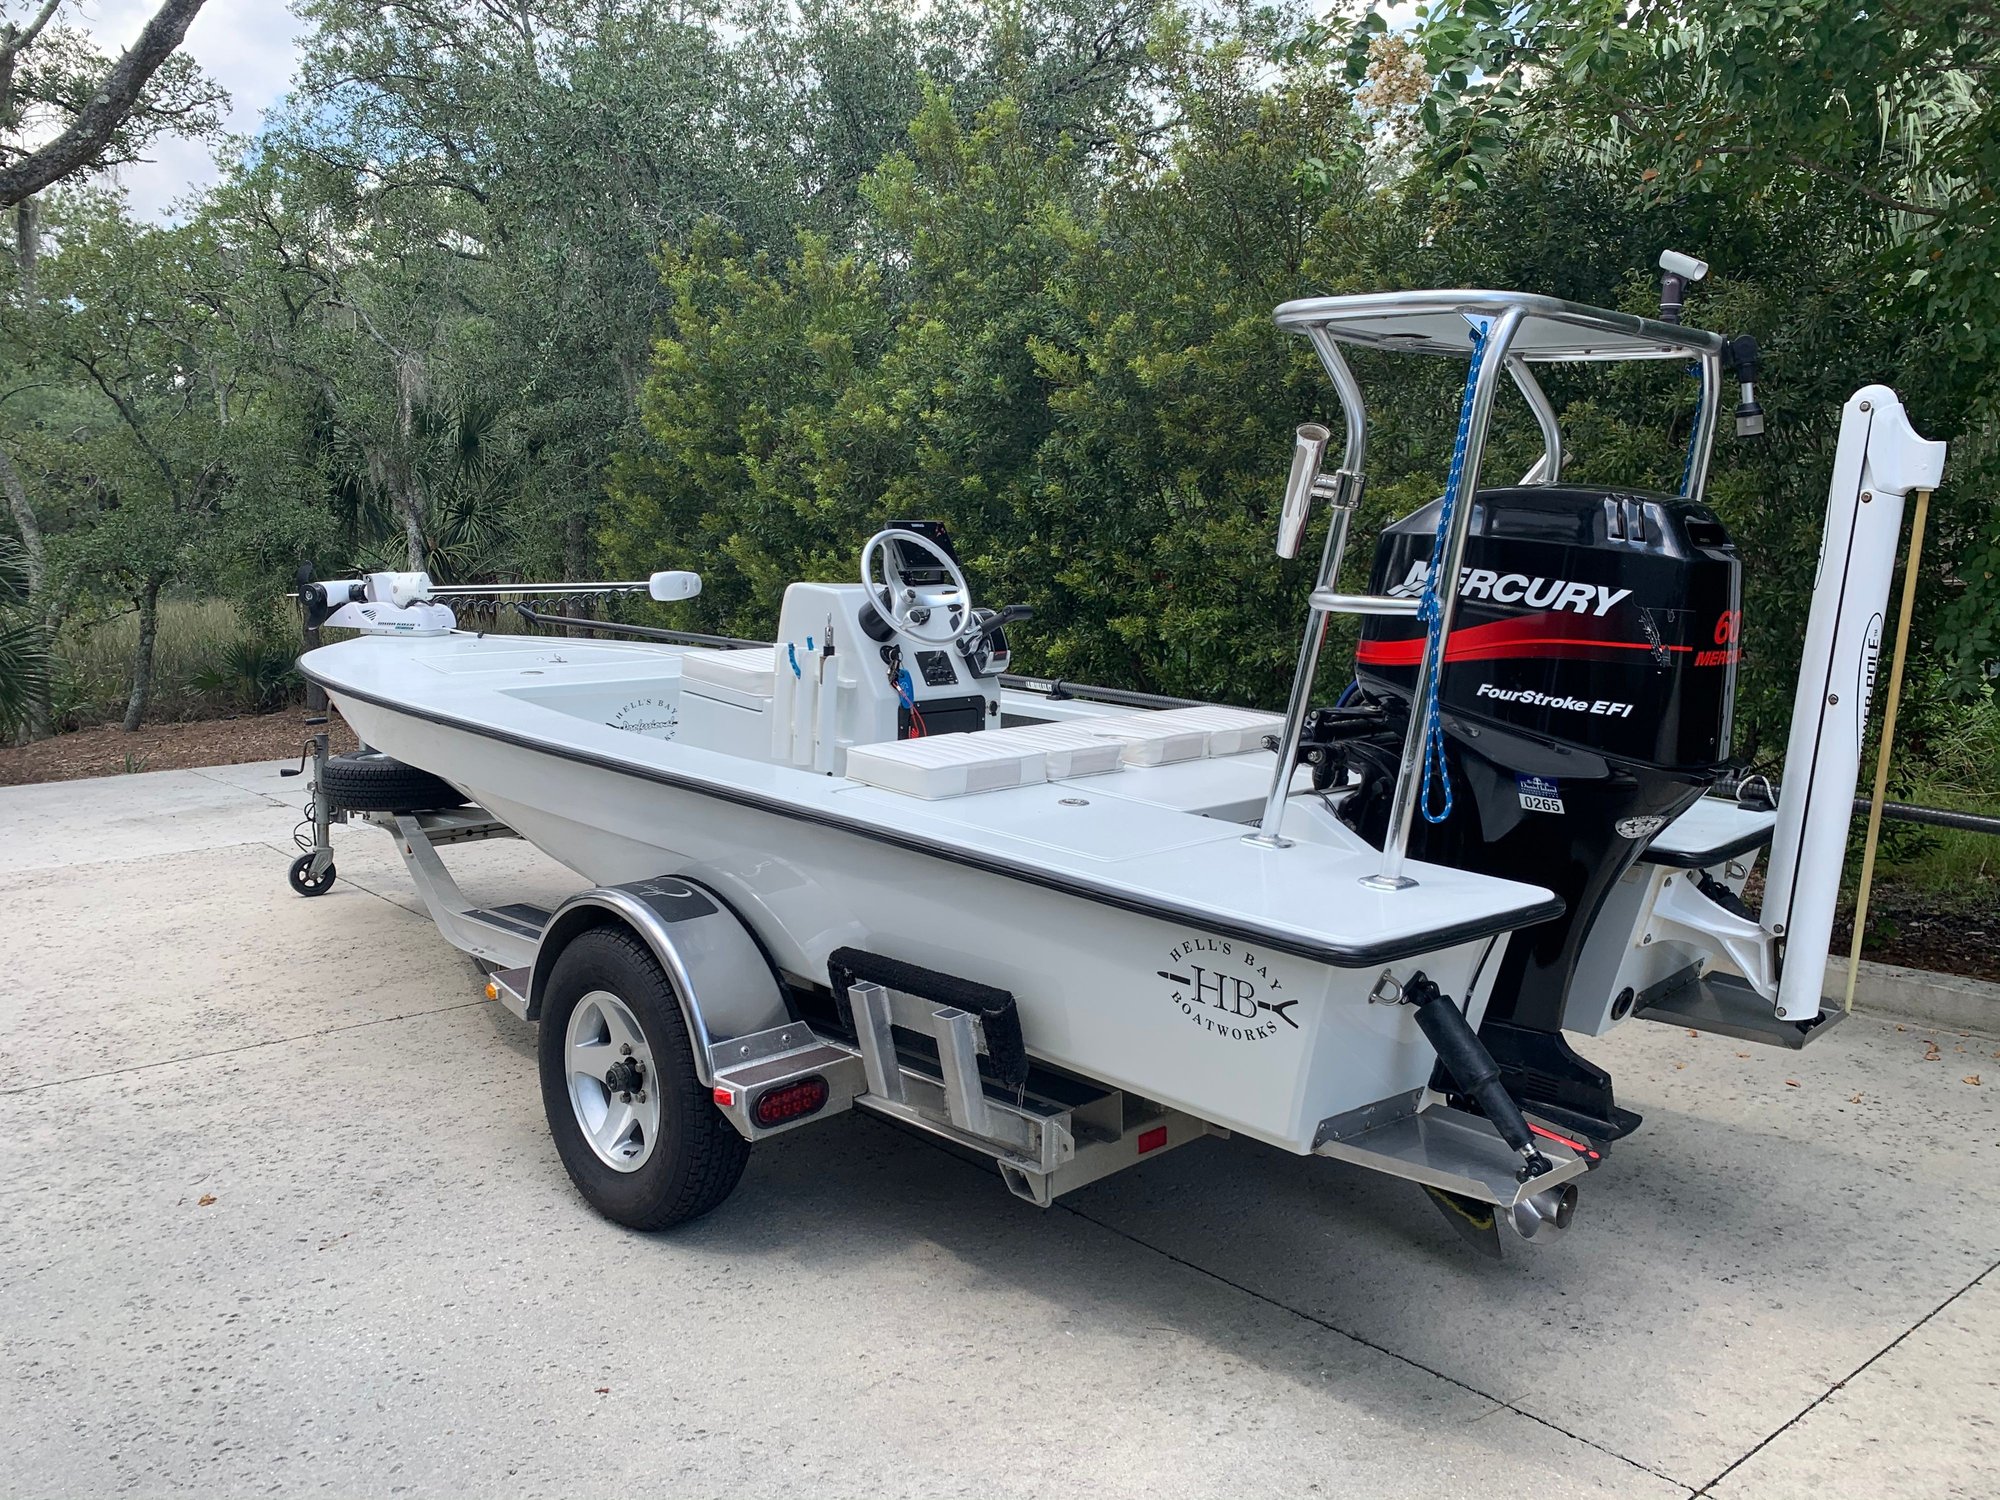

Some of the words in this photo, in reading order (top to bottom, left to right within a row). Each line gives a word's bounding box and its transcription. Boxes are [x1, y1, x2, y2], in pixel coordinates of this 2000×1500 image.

[658, 700, 678, 714] BAY
[1476, 683, 1589, 712] FourStroke
[1590, 700, 1634, 718] EFI
[1524, 796, 1560, 812] 0265
[1169, 938, 1232, 963] HELL'S
[1244, 952, 1283, 991] BAY
[1191, 965, 1257, 1019] HB
[1171, 991, 1277, 1041] BOATWORKS
